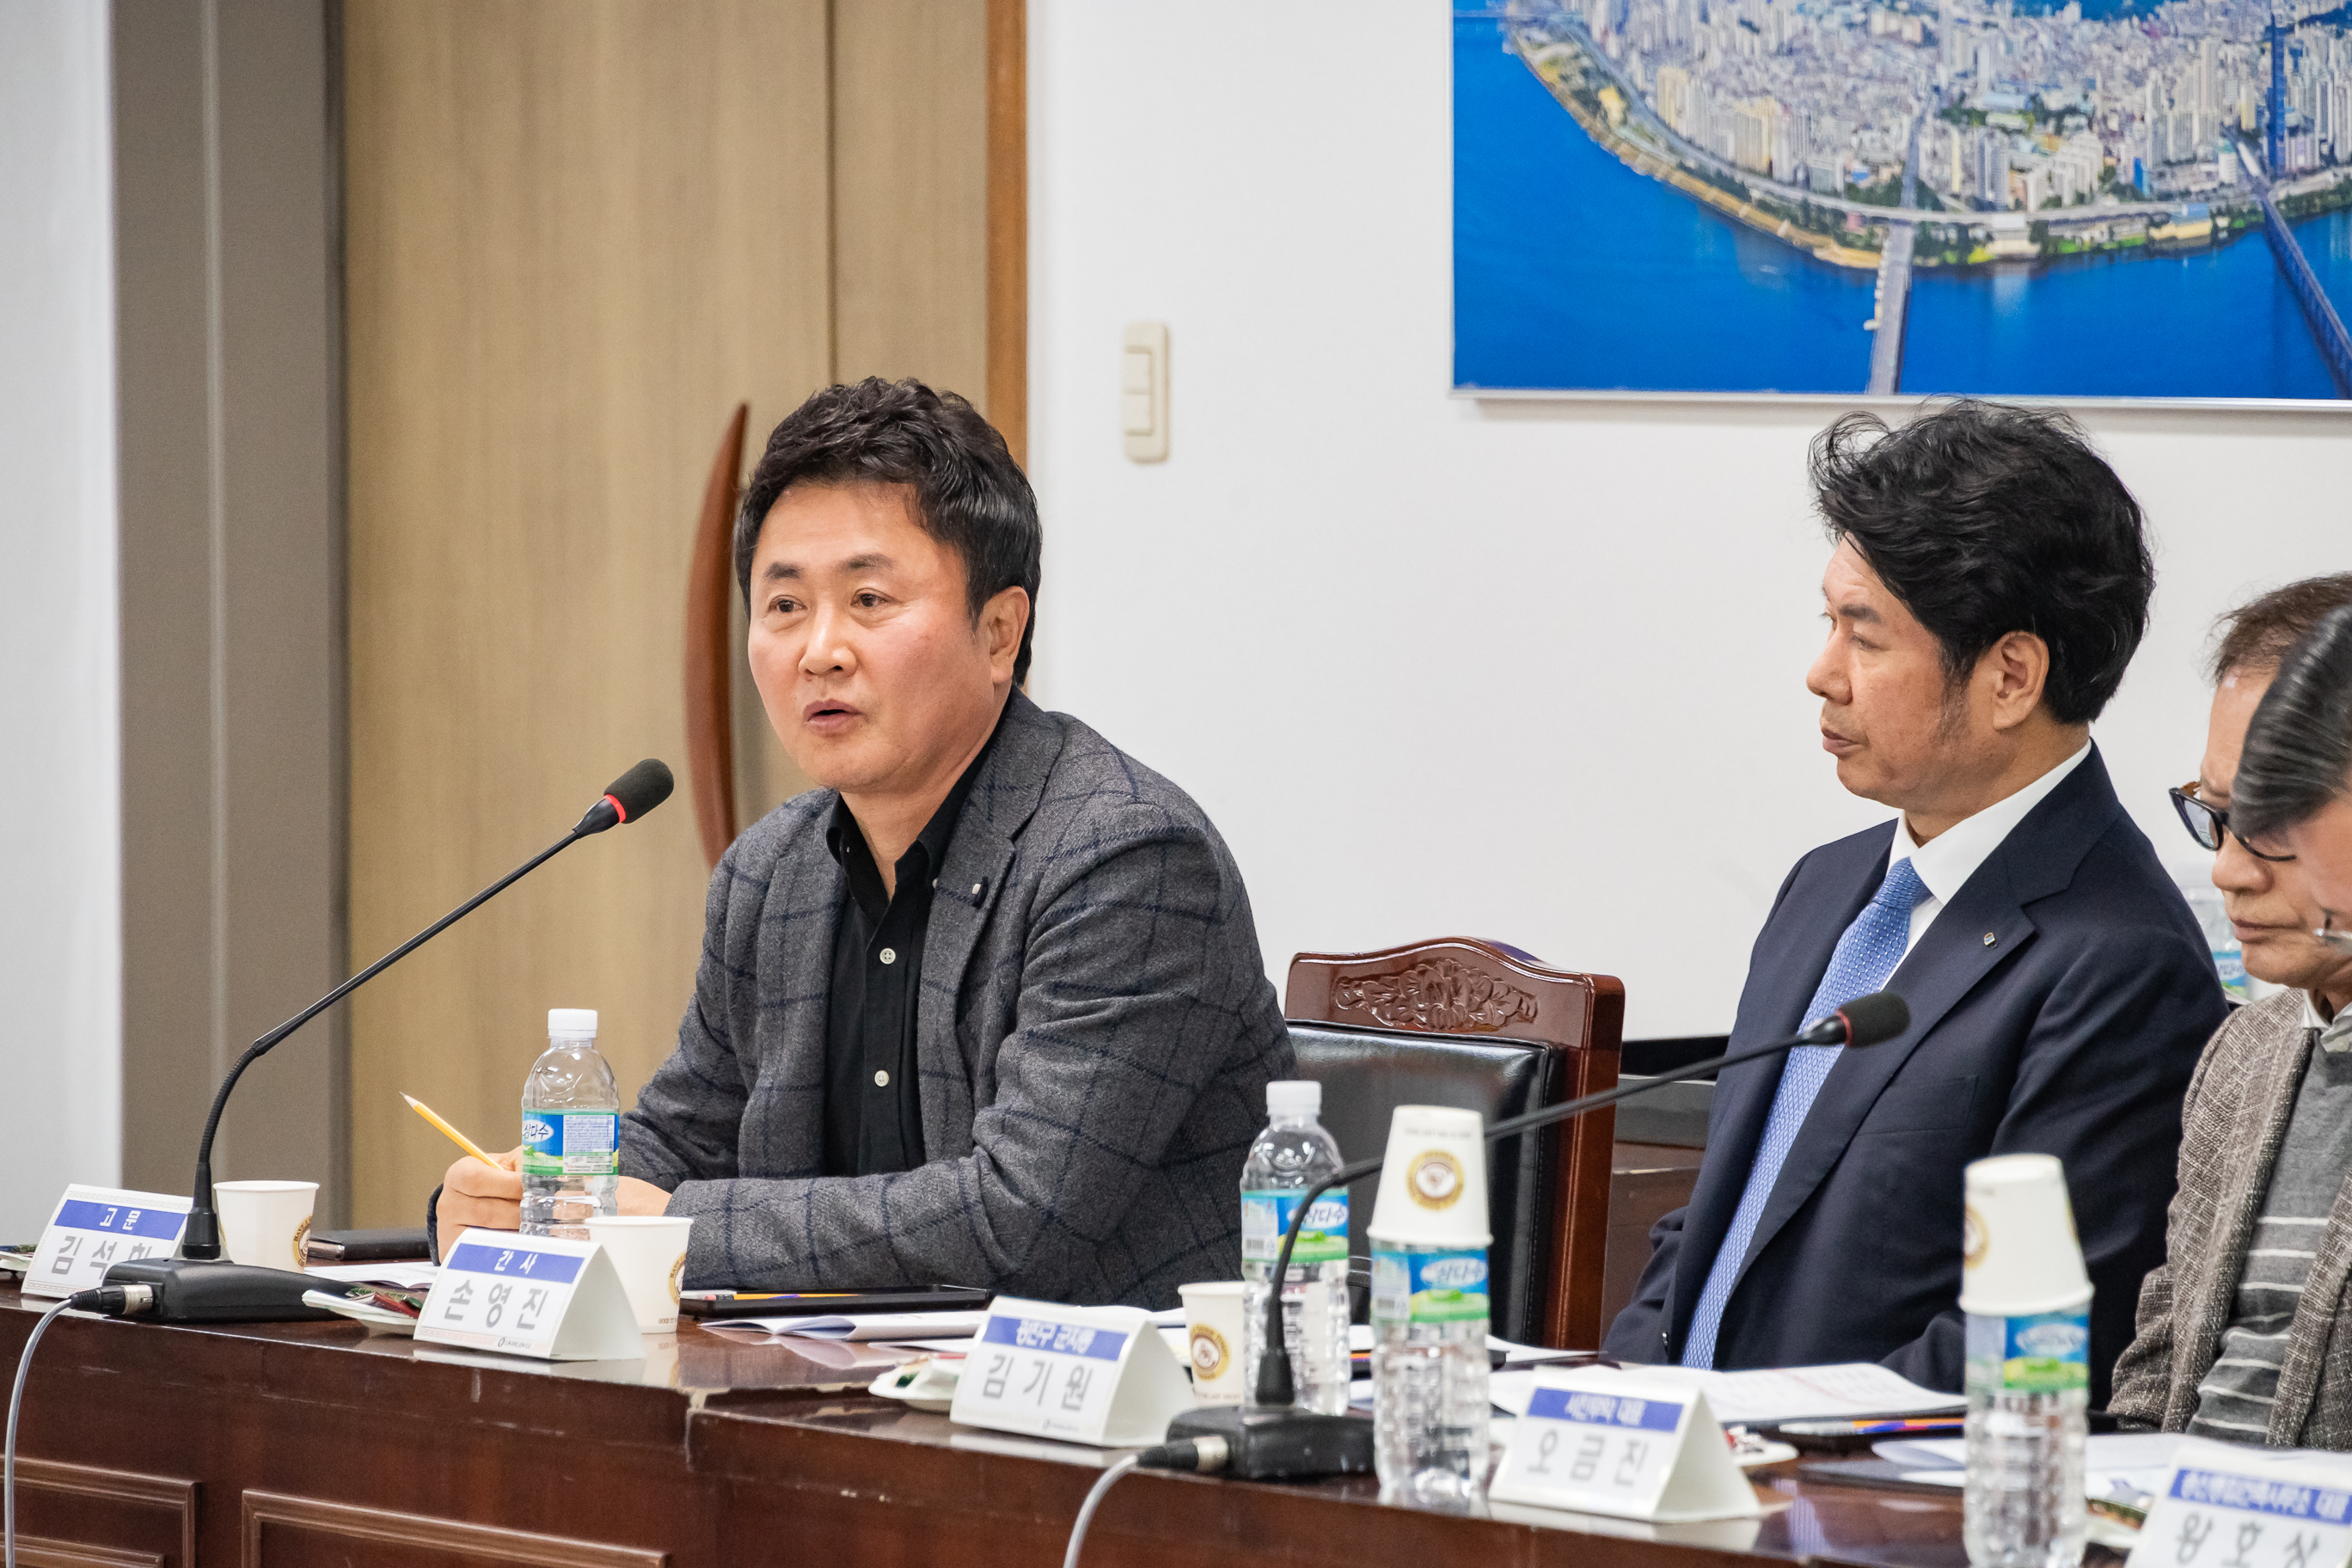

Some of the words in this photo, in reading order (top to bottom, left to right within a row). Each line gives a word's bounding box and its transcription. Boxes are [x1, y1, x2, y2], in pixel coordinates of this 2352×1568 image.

[523, 1124, 549, 1141] 삼다수
[99, 1207, 142, 1231] 고문
[493, 1250, 540, 1275] 간사
[444, 1279, 549, 1331] 손영진
[983, 1355, 1093, 1412] 김기원
[1527, 1430, 1650, 1486] 오금진
